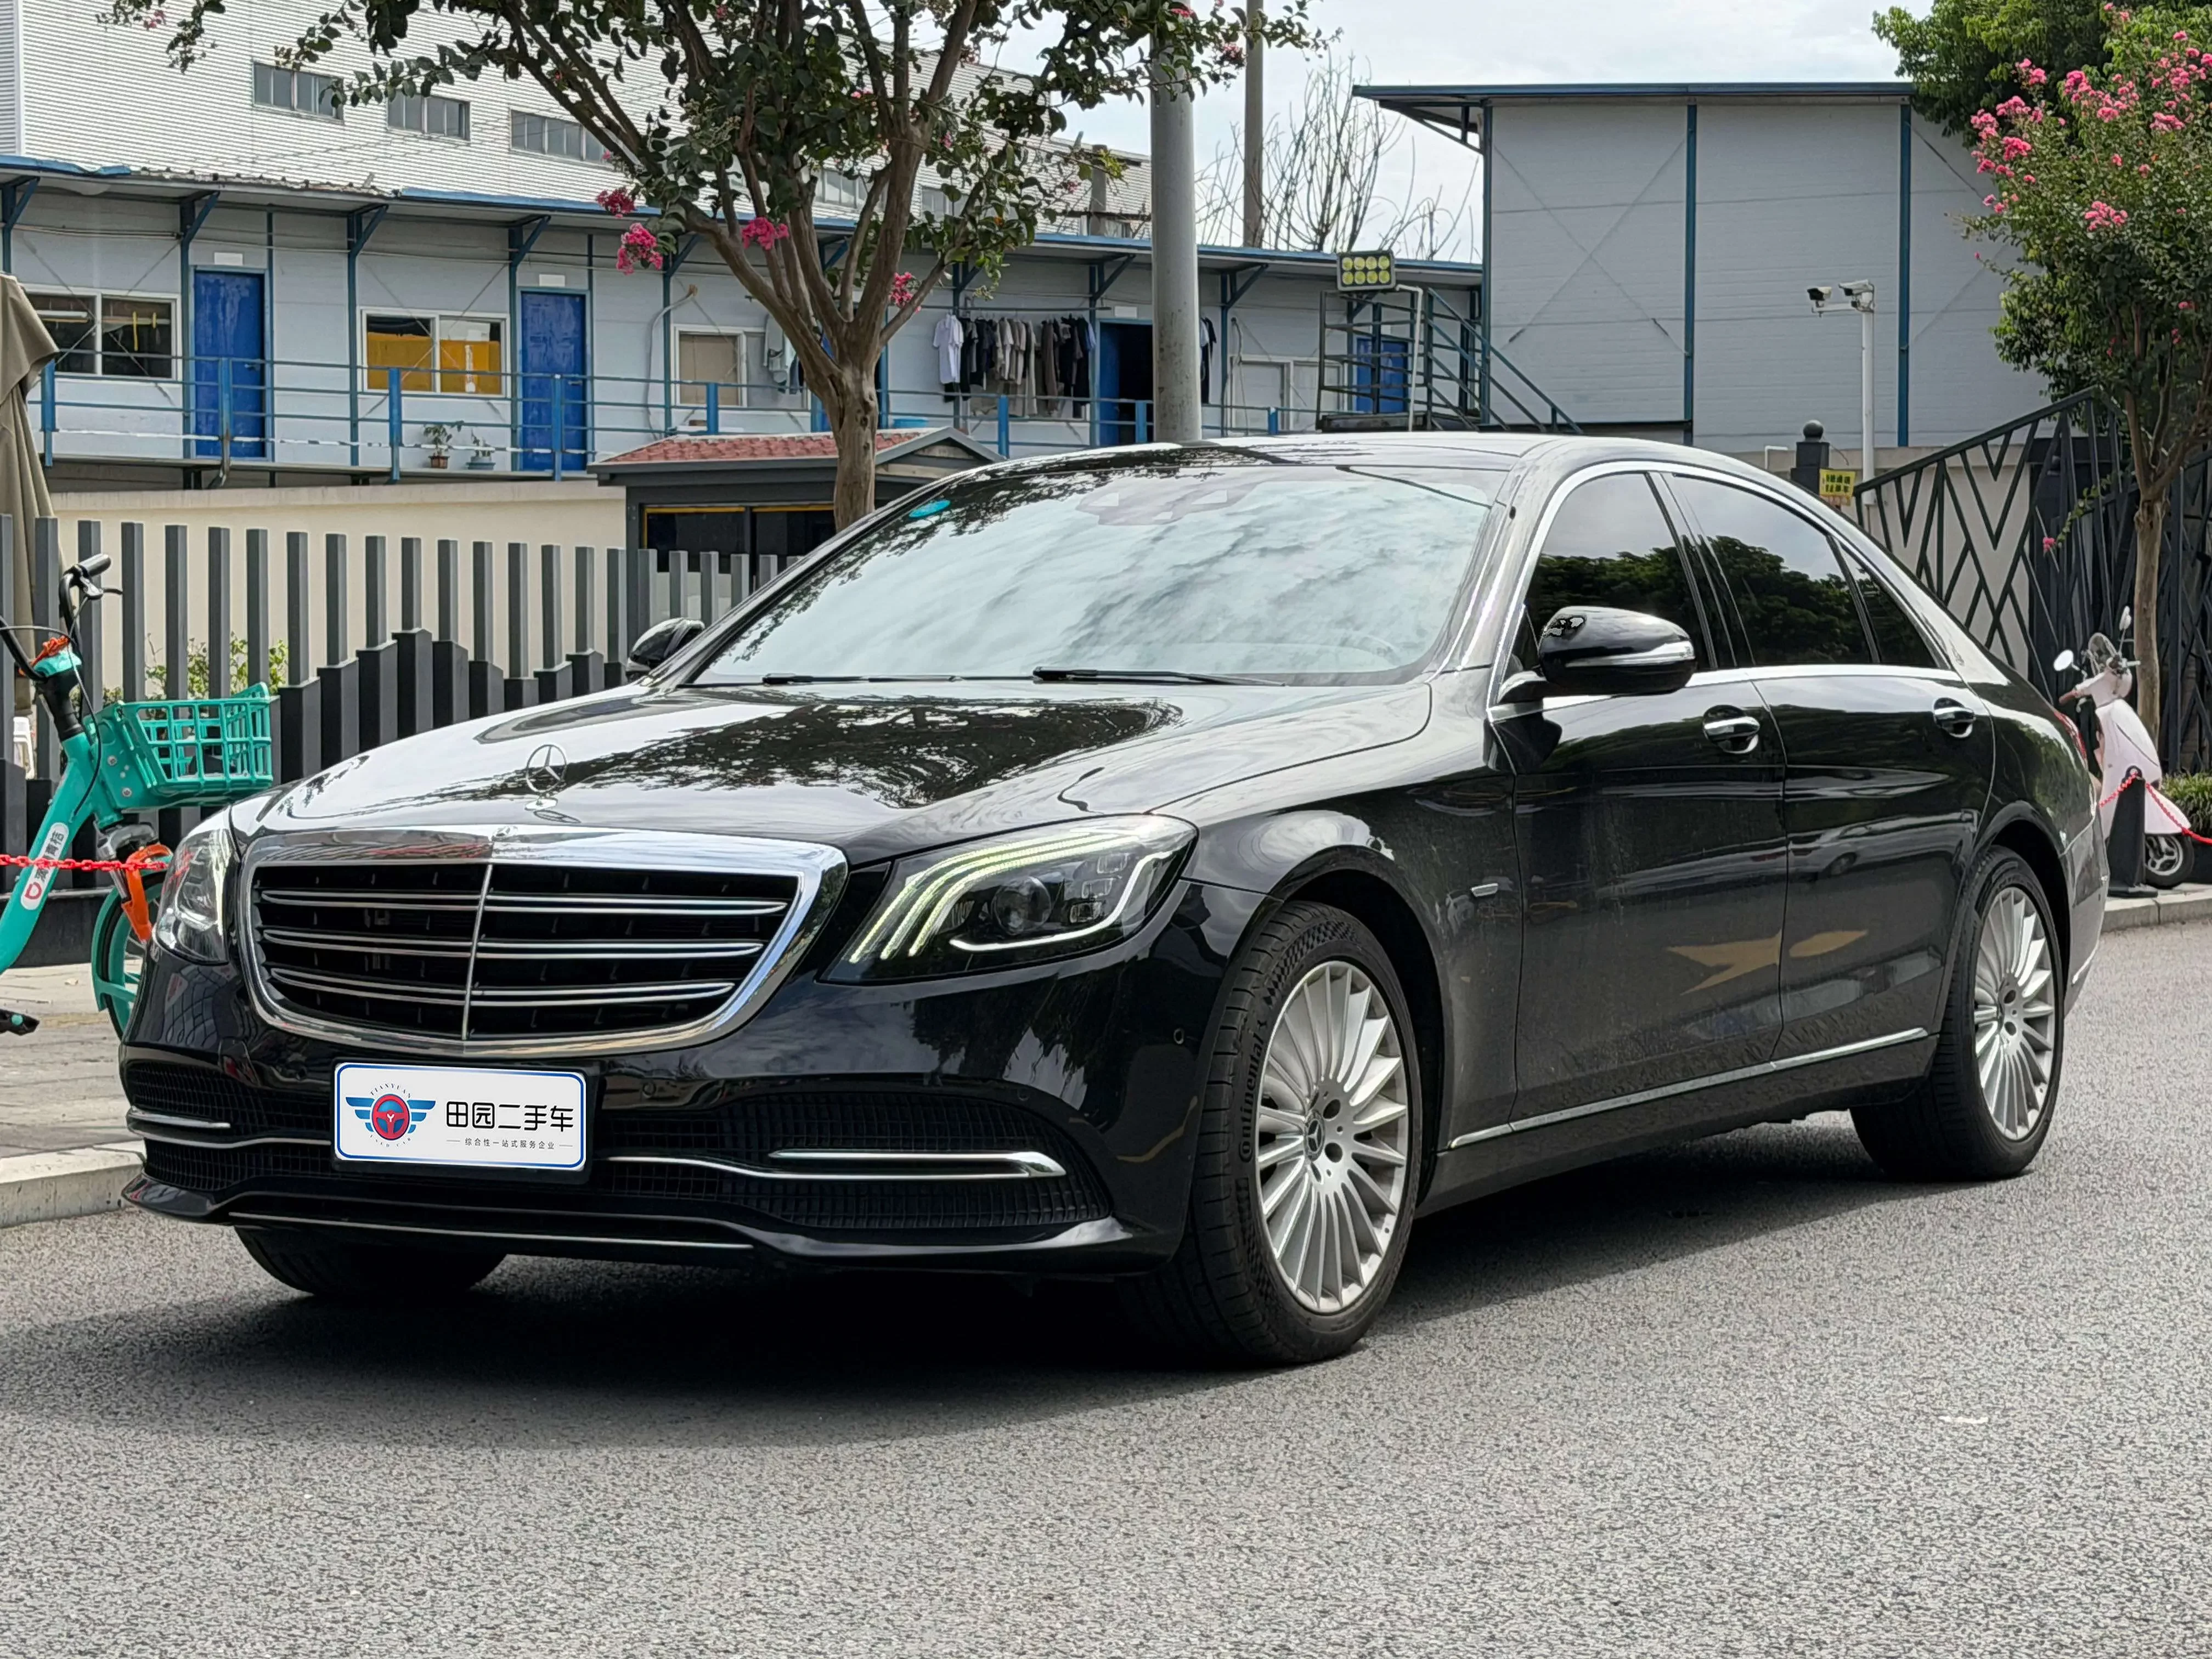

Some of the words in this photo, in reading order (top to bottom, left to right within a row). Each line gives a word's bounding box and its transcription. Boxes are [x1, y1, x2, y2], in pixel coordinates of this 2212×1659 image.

[1239, 1032, 1264, 1163] Continental
[446, 1101, 574, 1132] 田园二手车
[465, 1137, 555, 1150] 综合性一站式服务企业
